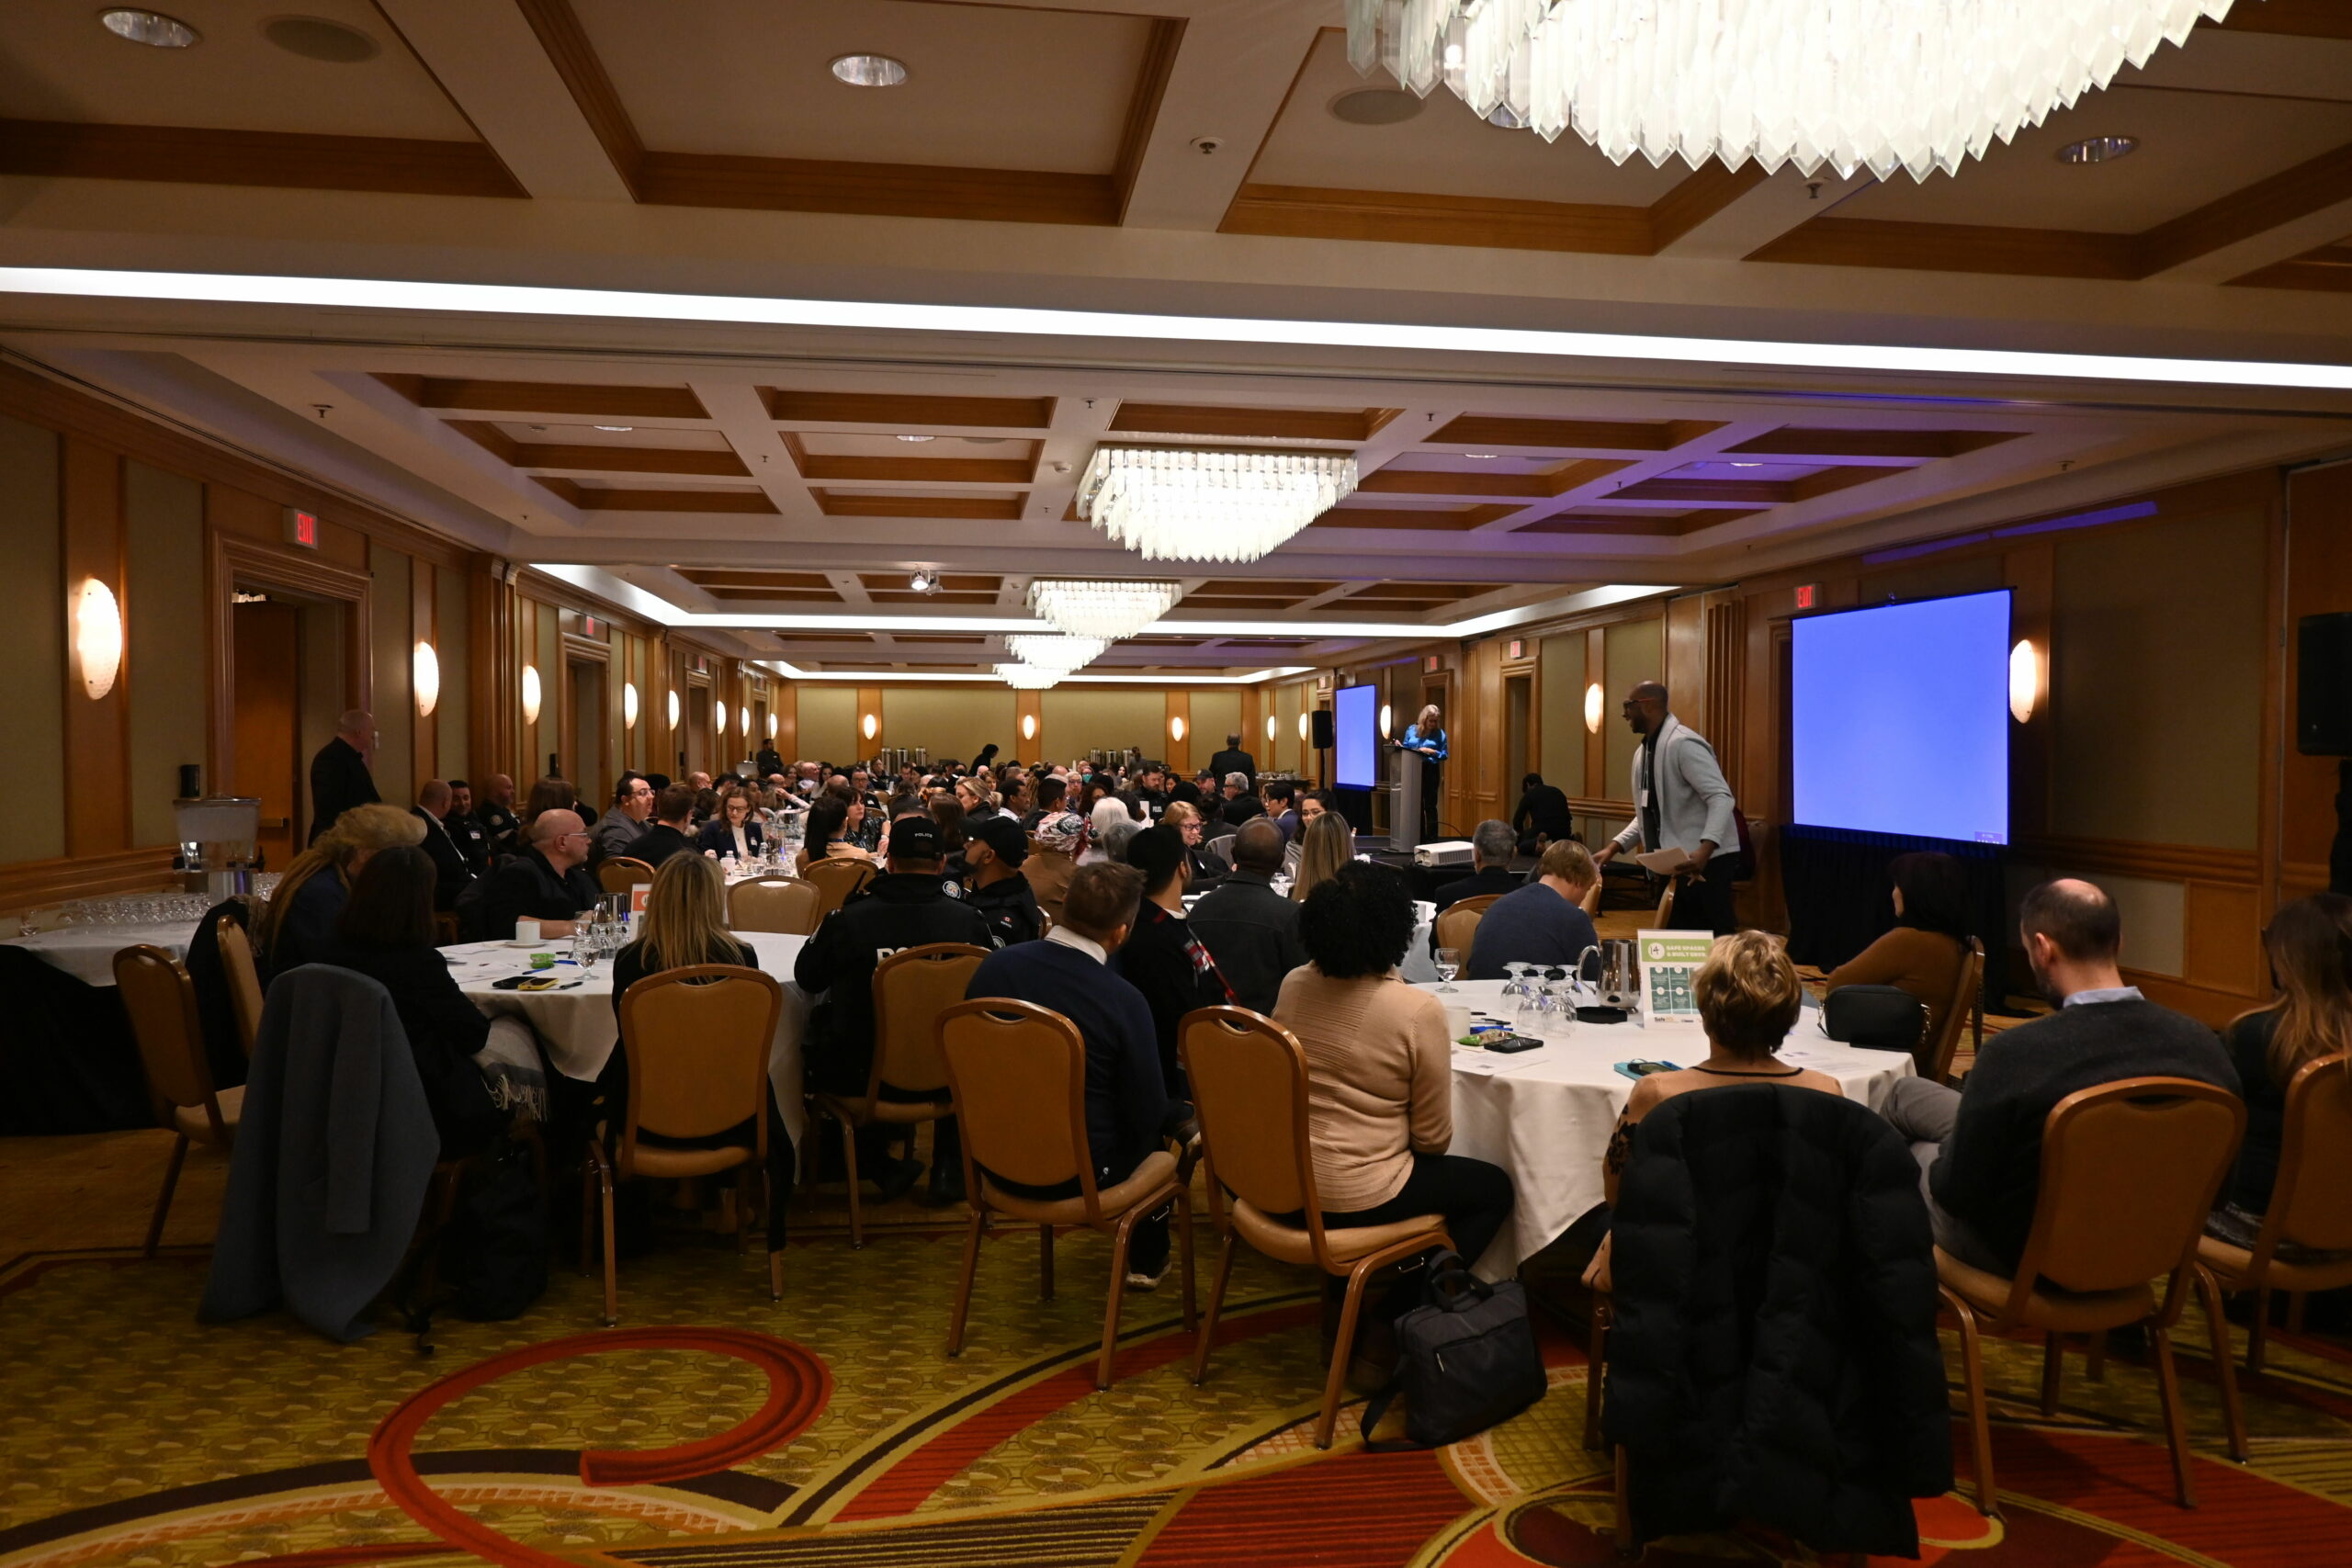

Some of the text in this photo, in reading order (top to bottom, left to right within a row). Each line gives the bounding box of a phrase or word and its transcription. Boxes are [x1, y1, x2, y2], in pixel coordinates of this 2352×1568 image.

[297, 513, 314, 544] EXIT
[1797, 586, 1813, 608] EXIT
[1650, 945, 1659, 955] 14
